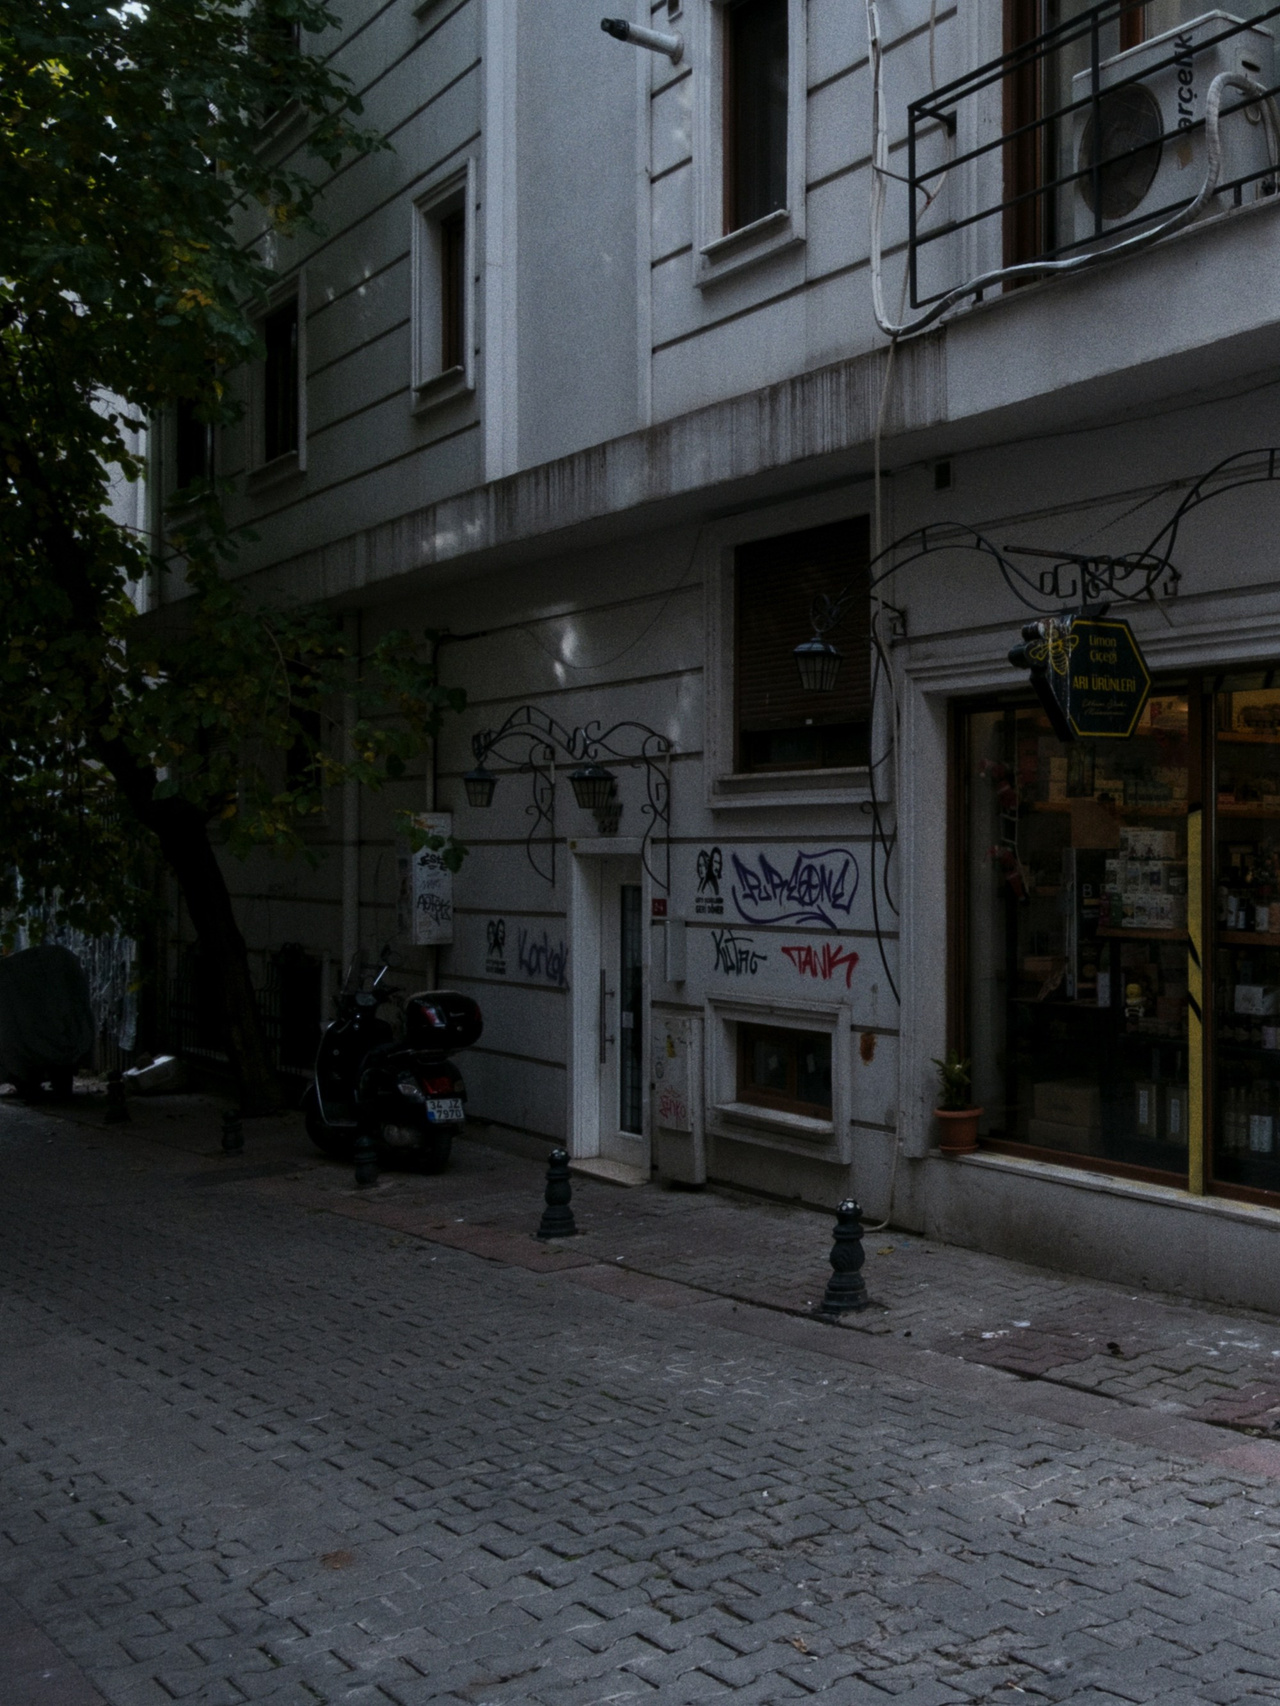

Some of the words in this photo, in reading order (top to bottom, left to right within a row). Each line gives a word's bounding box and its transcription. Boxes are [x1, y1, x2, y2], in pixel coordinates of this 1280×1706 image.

[1089, 634, 1117, 647] Limon
[1072, 675, 1089, 690] ARI
[1091, 673, 1136, 693] ÜRÜNLERİ
[781, 943, 860, 988] TANK
[430, 1101, 442, 1109] 34
